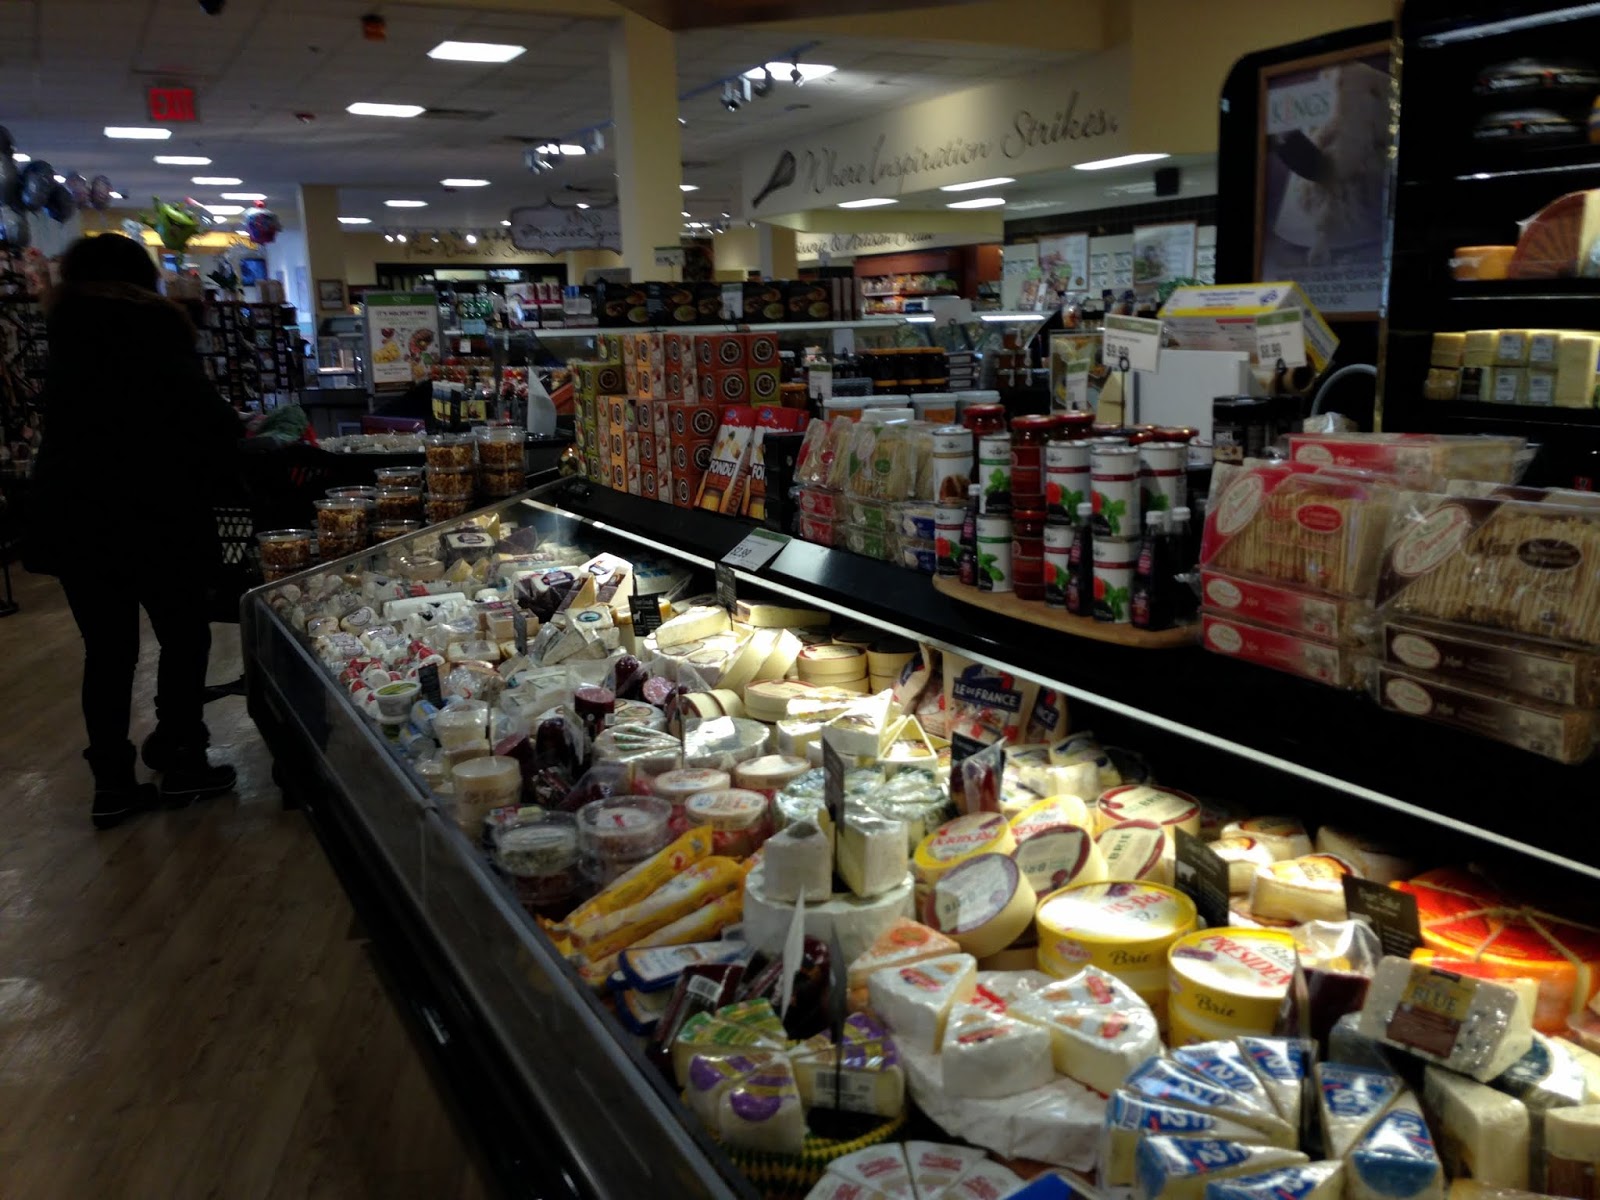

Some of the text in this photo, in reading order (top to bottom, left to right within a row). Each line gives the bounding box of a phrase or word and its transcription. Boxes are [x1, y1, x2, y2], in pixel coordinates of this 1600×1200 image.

[150, 88, 196, 121] EXIT
[1271, 91, 1332, 124] KINGS
[802, 147, 866, 194] Where
[867, 134, 992, 188] Inspiration
[975, 688, 1018, 707] FRANCE
[1108, 833, 1133, 860] BRIE
[1109, 950, 1150, 967] Brie
[1194, 993, 1236, 1017] Brie
